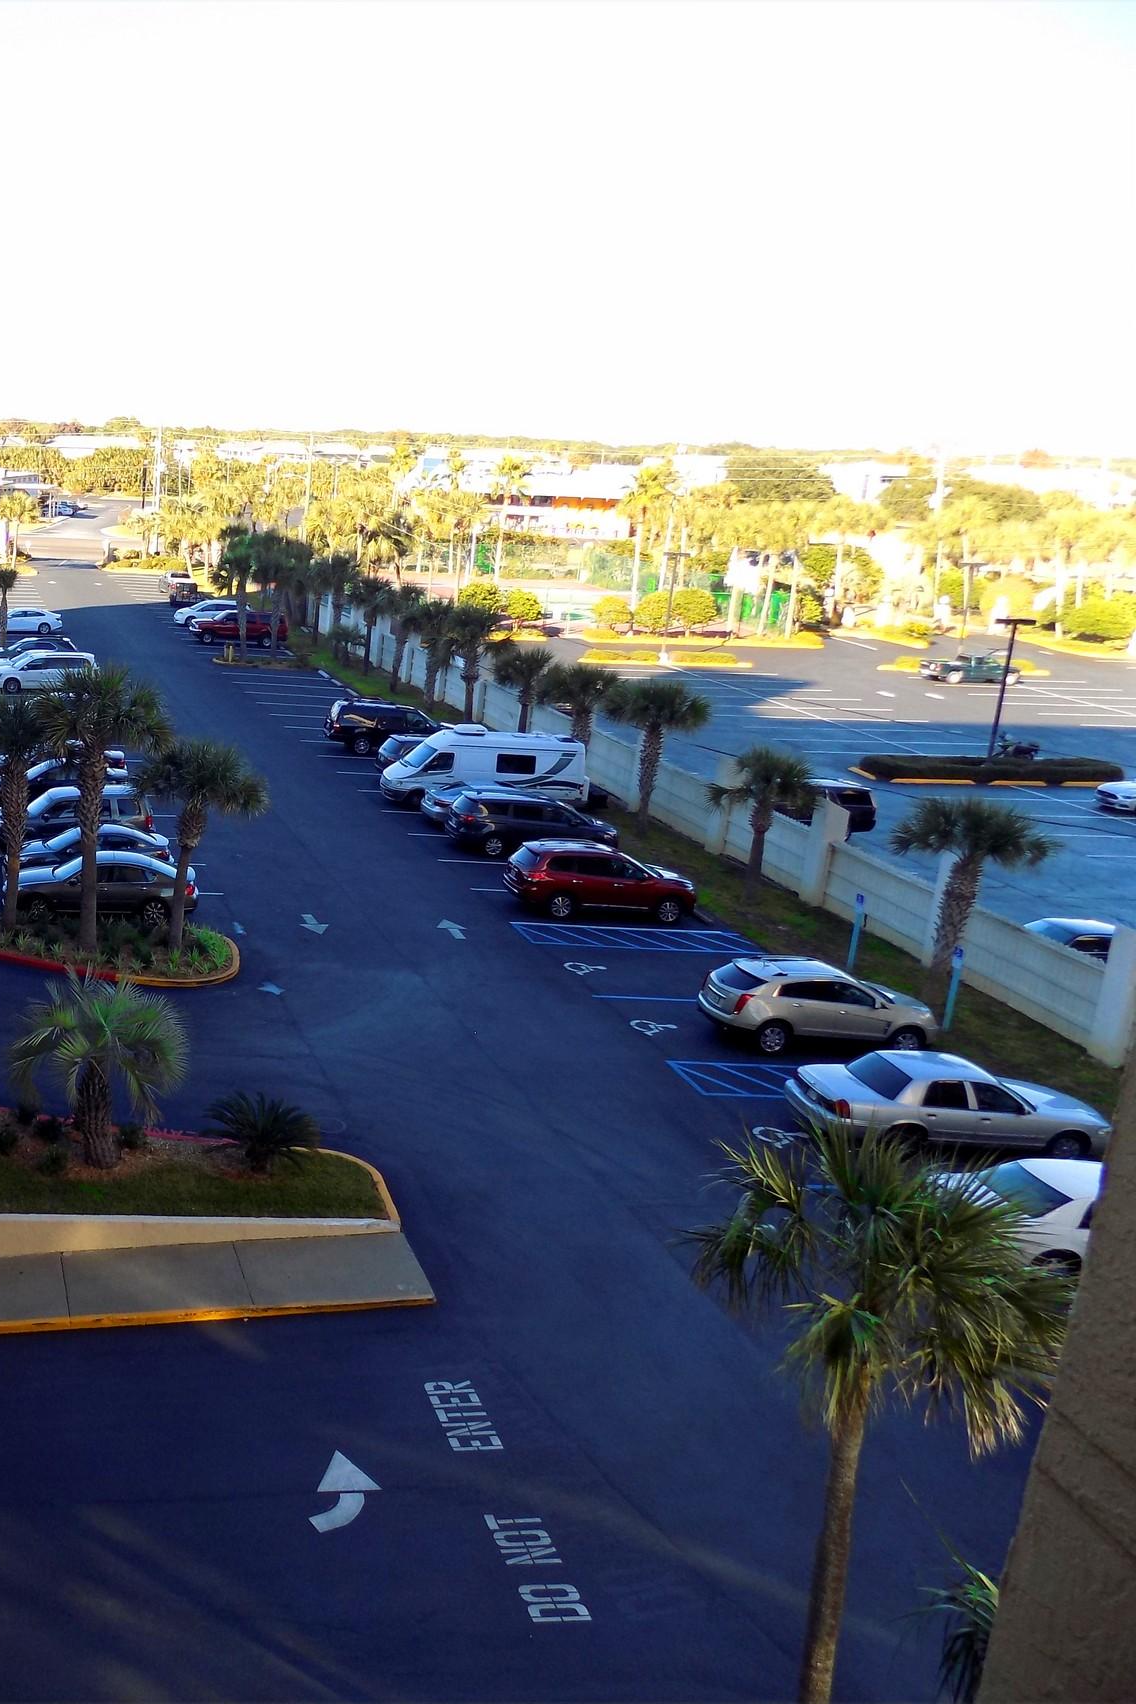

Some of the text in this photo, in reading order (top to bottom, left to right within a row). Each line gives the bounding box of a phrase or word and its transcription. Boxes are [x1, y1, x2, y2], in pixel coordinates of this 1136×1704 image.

[423, 1380, 593, 1623] DO NOT ENTER
